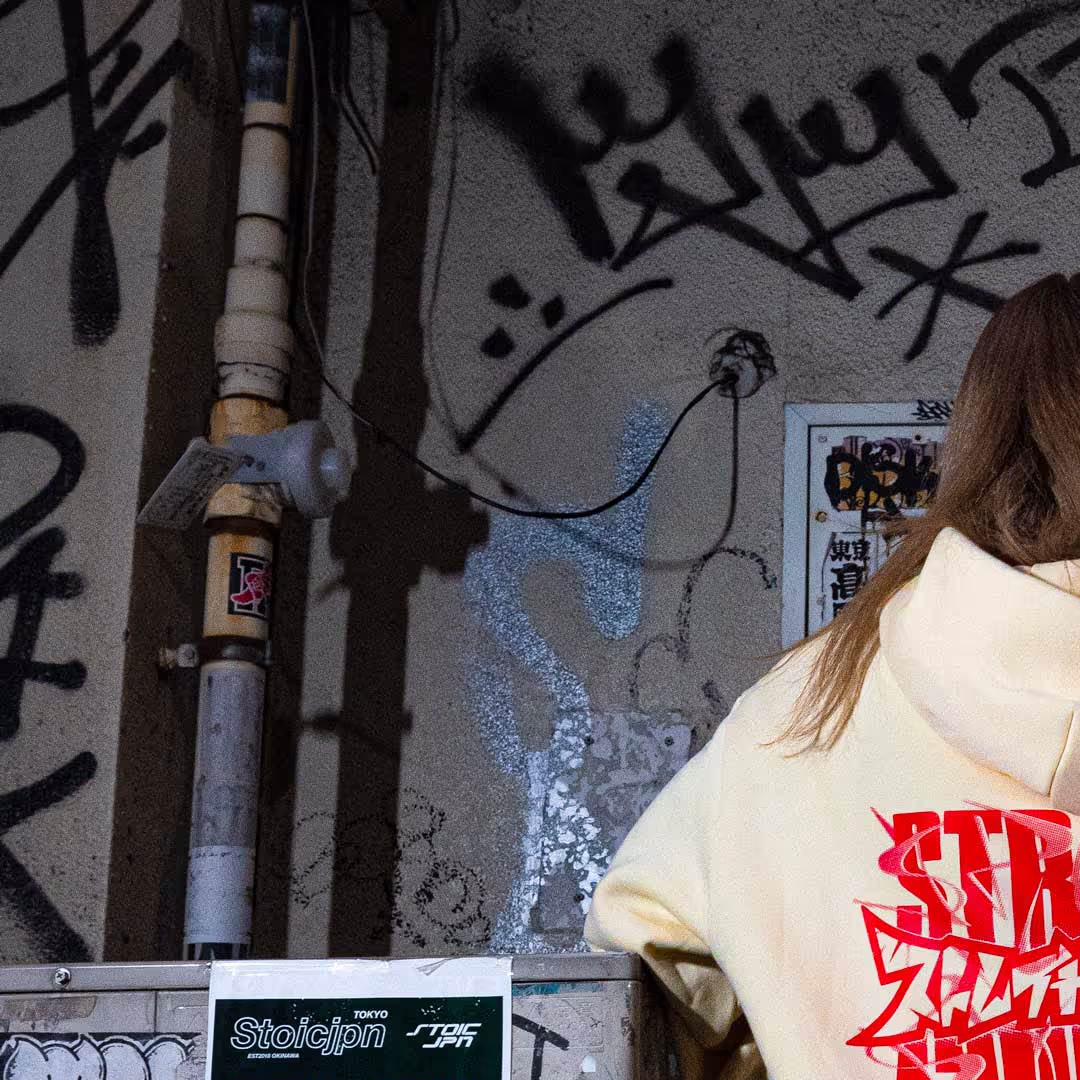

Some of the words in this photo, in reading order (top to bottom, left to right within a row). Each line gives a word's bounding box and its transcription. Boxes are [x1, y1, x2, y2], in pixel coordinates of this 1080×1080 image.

[830, 538, 871, 563] 東京
[353, 1009, 389, 1020] TOKYO
[230, 1016, 387, 1056] Stoicjpn
[406, 1022, 482, 1037] STOIC
